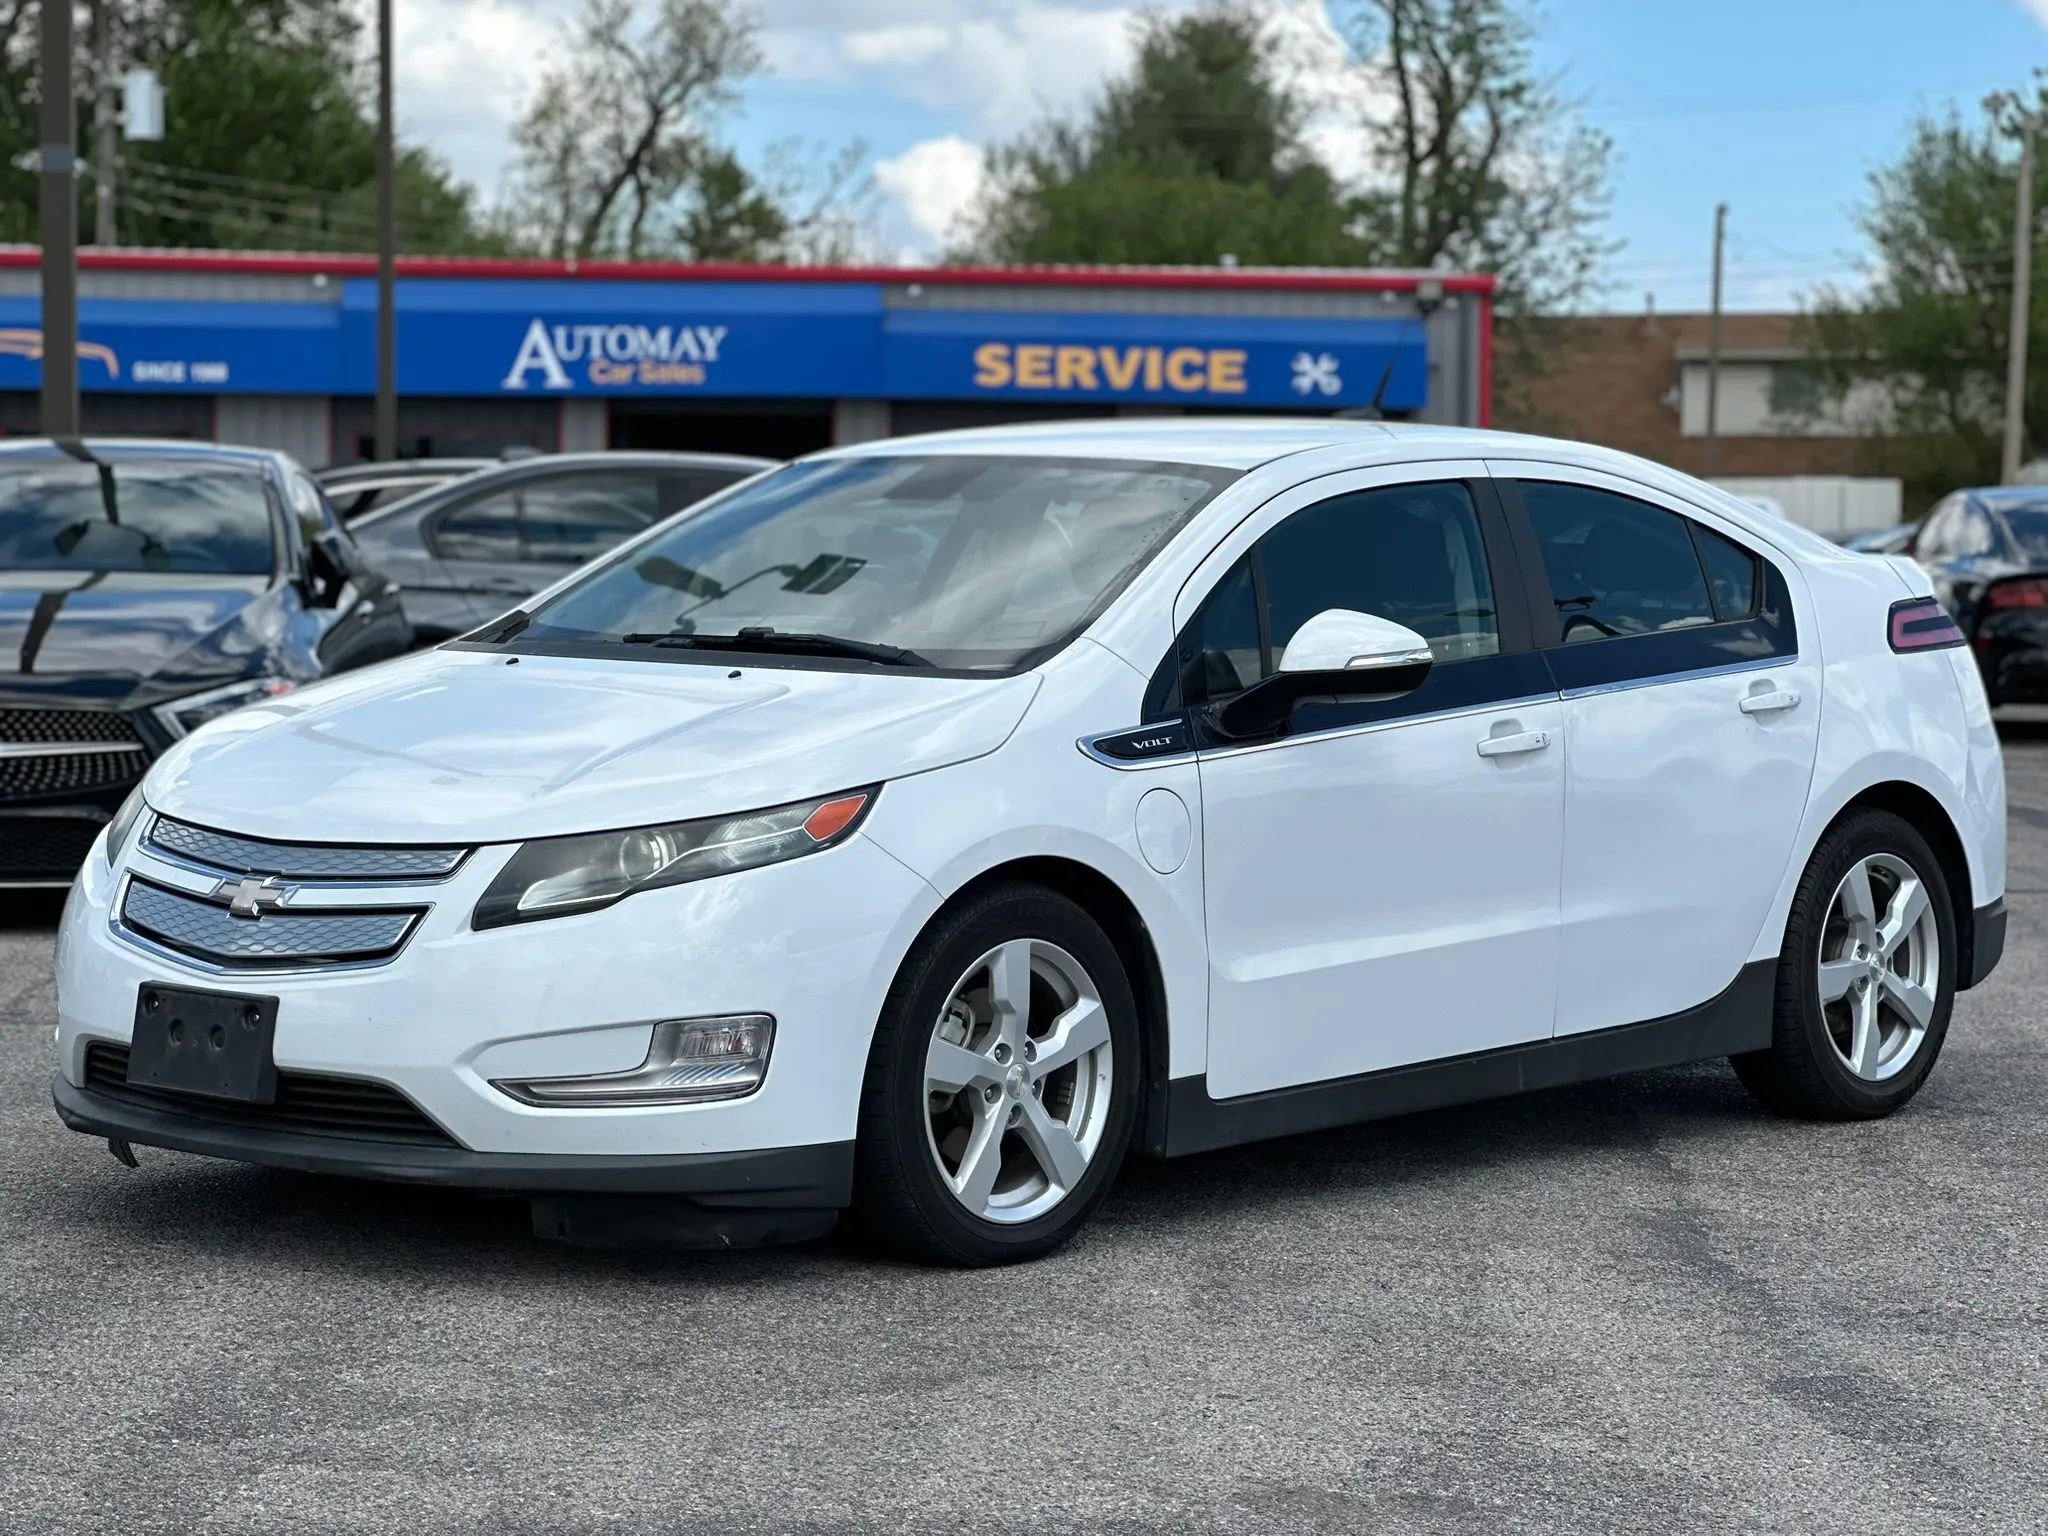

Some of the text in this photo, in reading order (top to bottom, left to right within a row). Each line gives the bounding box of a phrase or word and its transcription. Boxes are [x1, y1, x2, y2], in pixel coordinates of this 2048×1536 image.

[501, 317, 728, 389] AUTOMAY
[132, 361, 186, 383] SINCE
[589, 359, 706, 385] Car Sales
[974, 344, 1248, 393] SERVICE
[1131, 736, 1173, 749] VOLT
